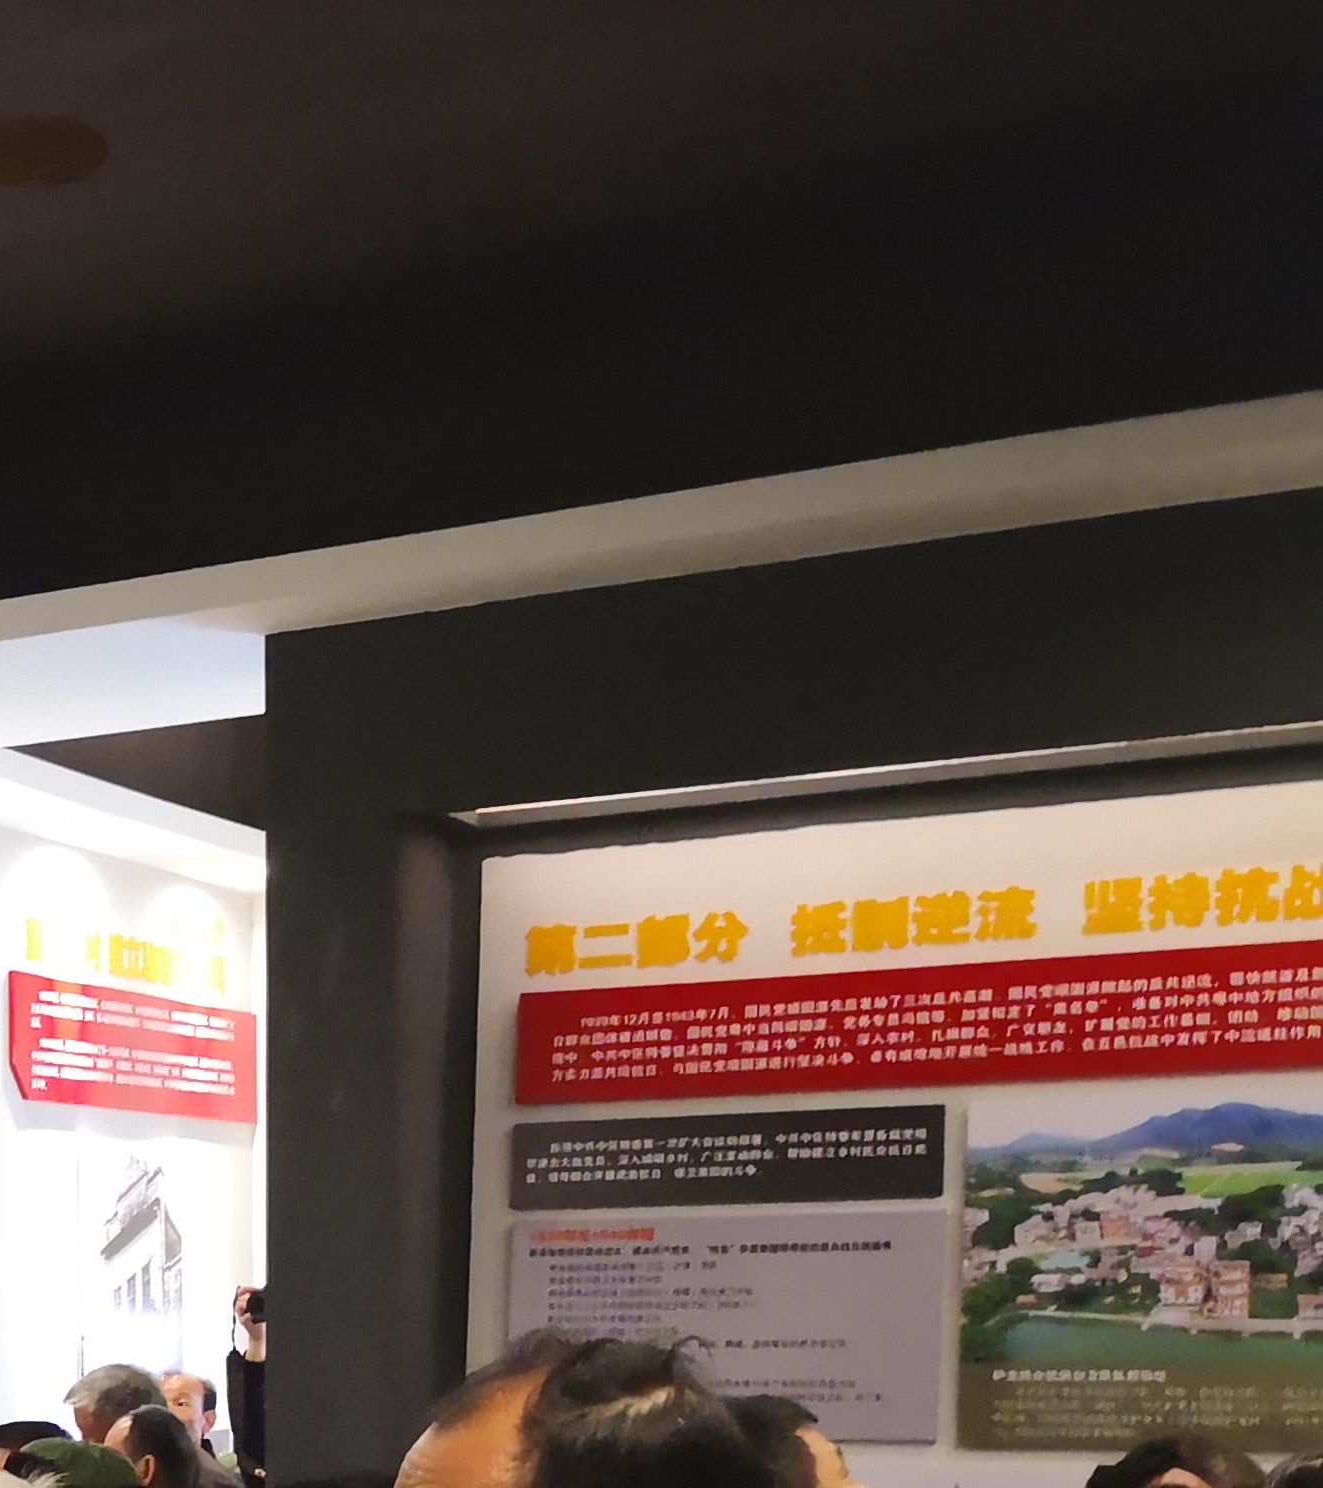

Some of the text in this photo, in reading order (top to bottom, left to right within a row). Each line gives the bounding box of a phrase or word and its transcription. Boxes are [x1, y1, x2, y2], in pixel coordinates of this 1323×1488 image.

[525, 911, 749, 977] 第二部分
[791, 886, 1038, 958] 抵制逆流
